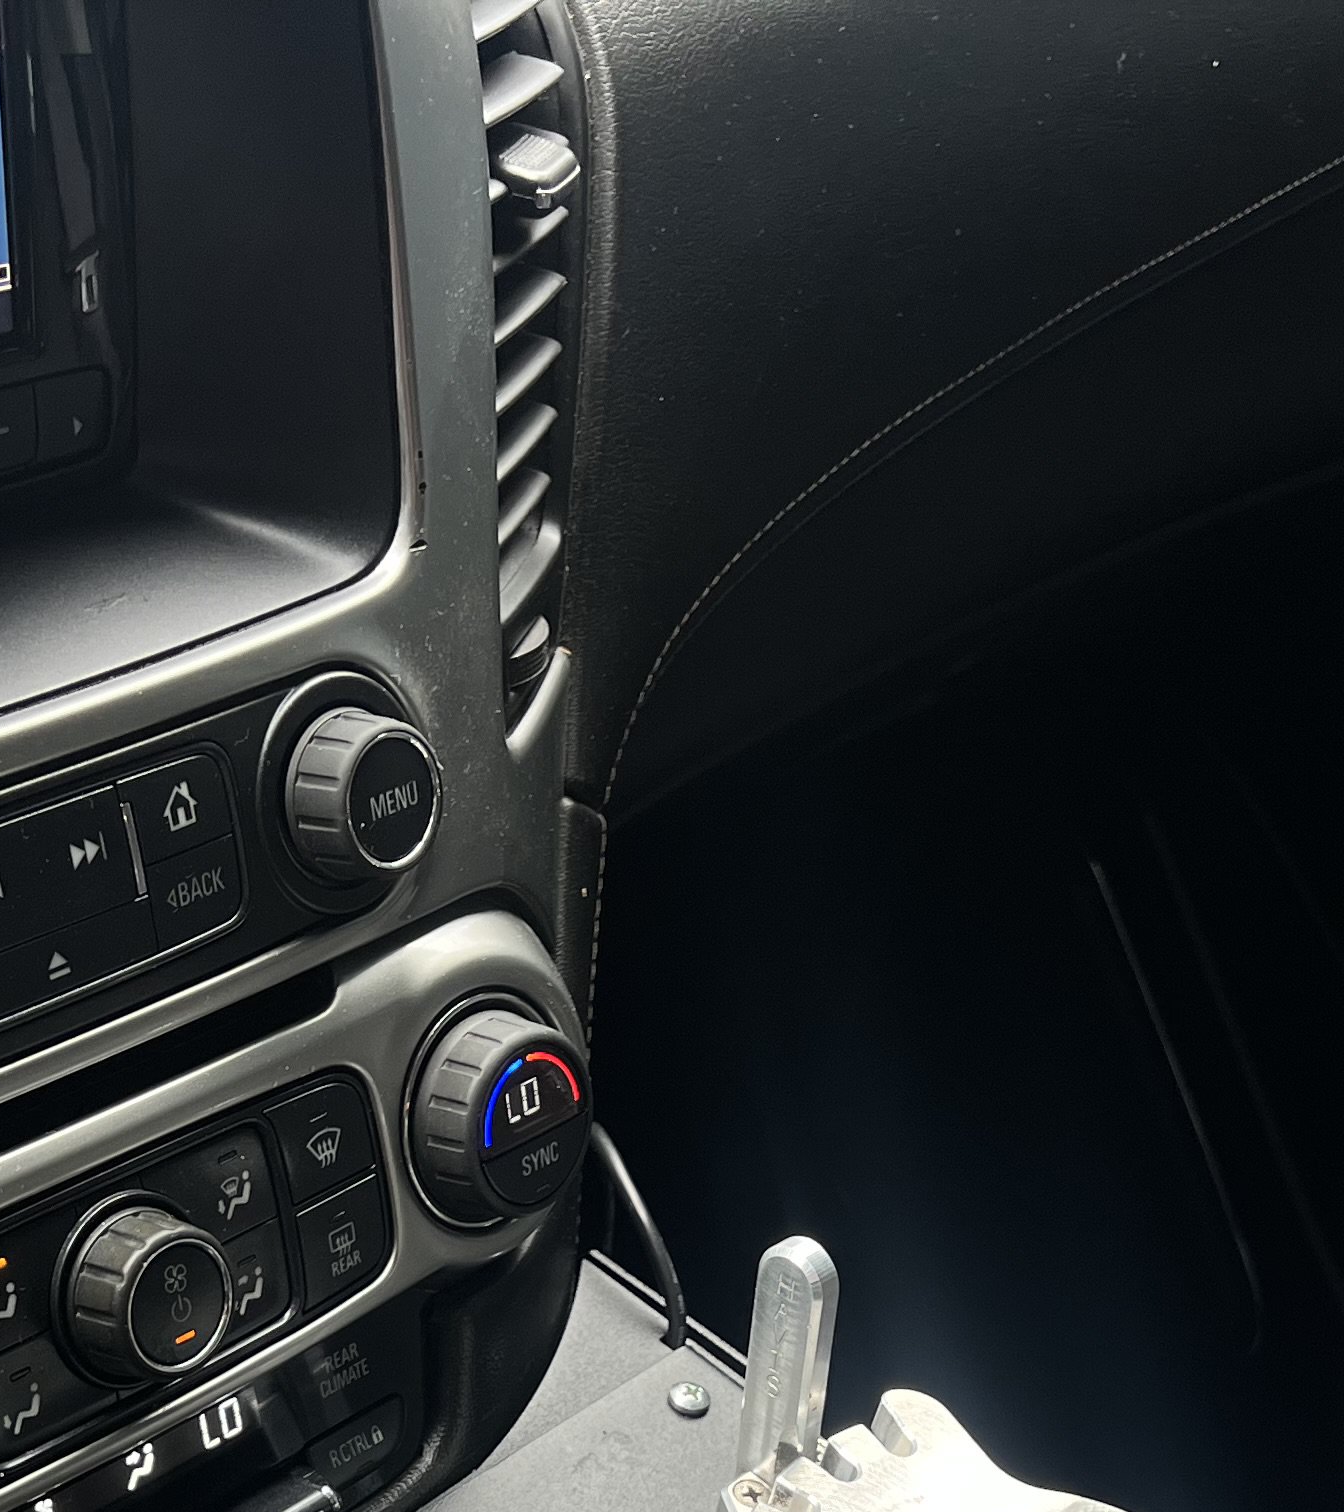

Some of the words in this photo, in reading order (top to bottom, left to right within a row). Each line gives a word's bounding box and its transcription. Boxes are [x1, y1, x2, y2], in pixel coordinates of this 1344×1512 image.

[369, 780, 419, 821] MENU
[177, 867, 226, 909] BACK
[505, 1076, 541, 1124] LO
[521, 1141, 560, 1177] SYNC
[330, 1250, 362, 1278] REAR
[319, 1357, 371, 1399] CLIMATE
[324, 1342, 360, 1374] REAR
[198, 1396, 244, 1450] LO
